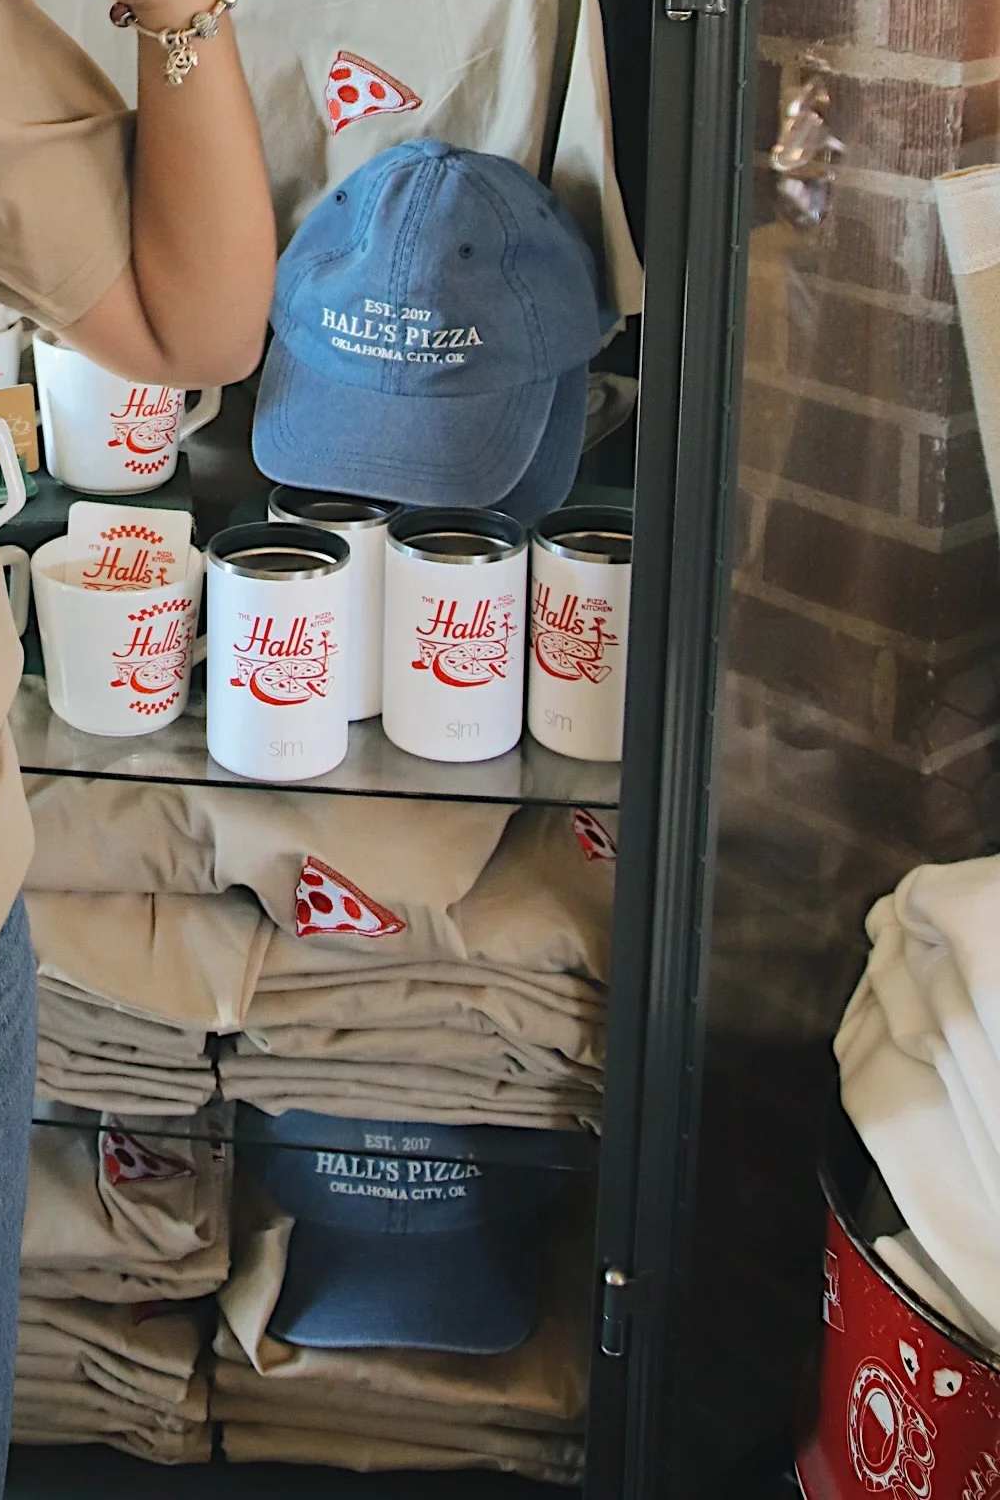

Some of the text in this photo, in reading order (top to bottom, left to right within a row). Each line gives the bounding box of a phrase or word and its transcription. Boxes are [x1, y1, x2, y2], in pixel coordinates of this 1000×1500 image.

[364, 299, 431, 322] EST. 2017
[321, 308, 483, 348] HALL'S PIZZA
[331, 336, 465, 364] OKLAHOMA CITY, OK
[82, 546, 153, 583] Hall's
[422, 596, 434, 605] THE
[532, 583, 585, 635] Hall's
[581, 603, 613, 612] KITCHEN
[586, 597, 608, 605] PIZZA
[238, 612, 251, 621] THE
[416, 599, 496, 639] Hall's
[112, 619, 182, 657] Hall's
[233, 616, 313, 657] Hall's
[364, 1134, 432, 1151] EST. 2017
[315, 1152, 399, 1182] HALL'S
[330, 1181, 408, 1200] OKLAHOMA
[450, 1185, 466, 1197] OK
